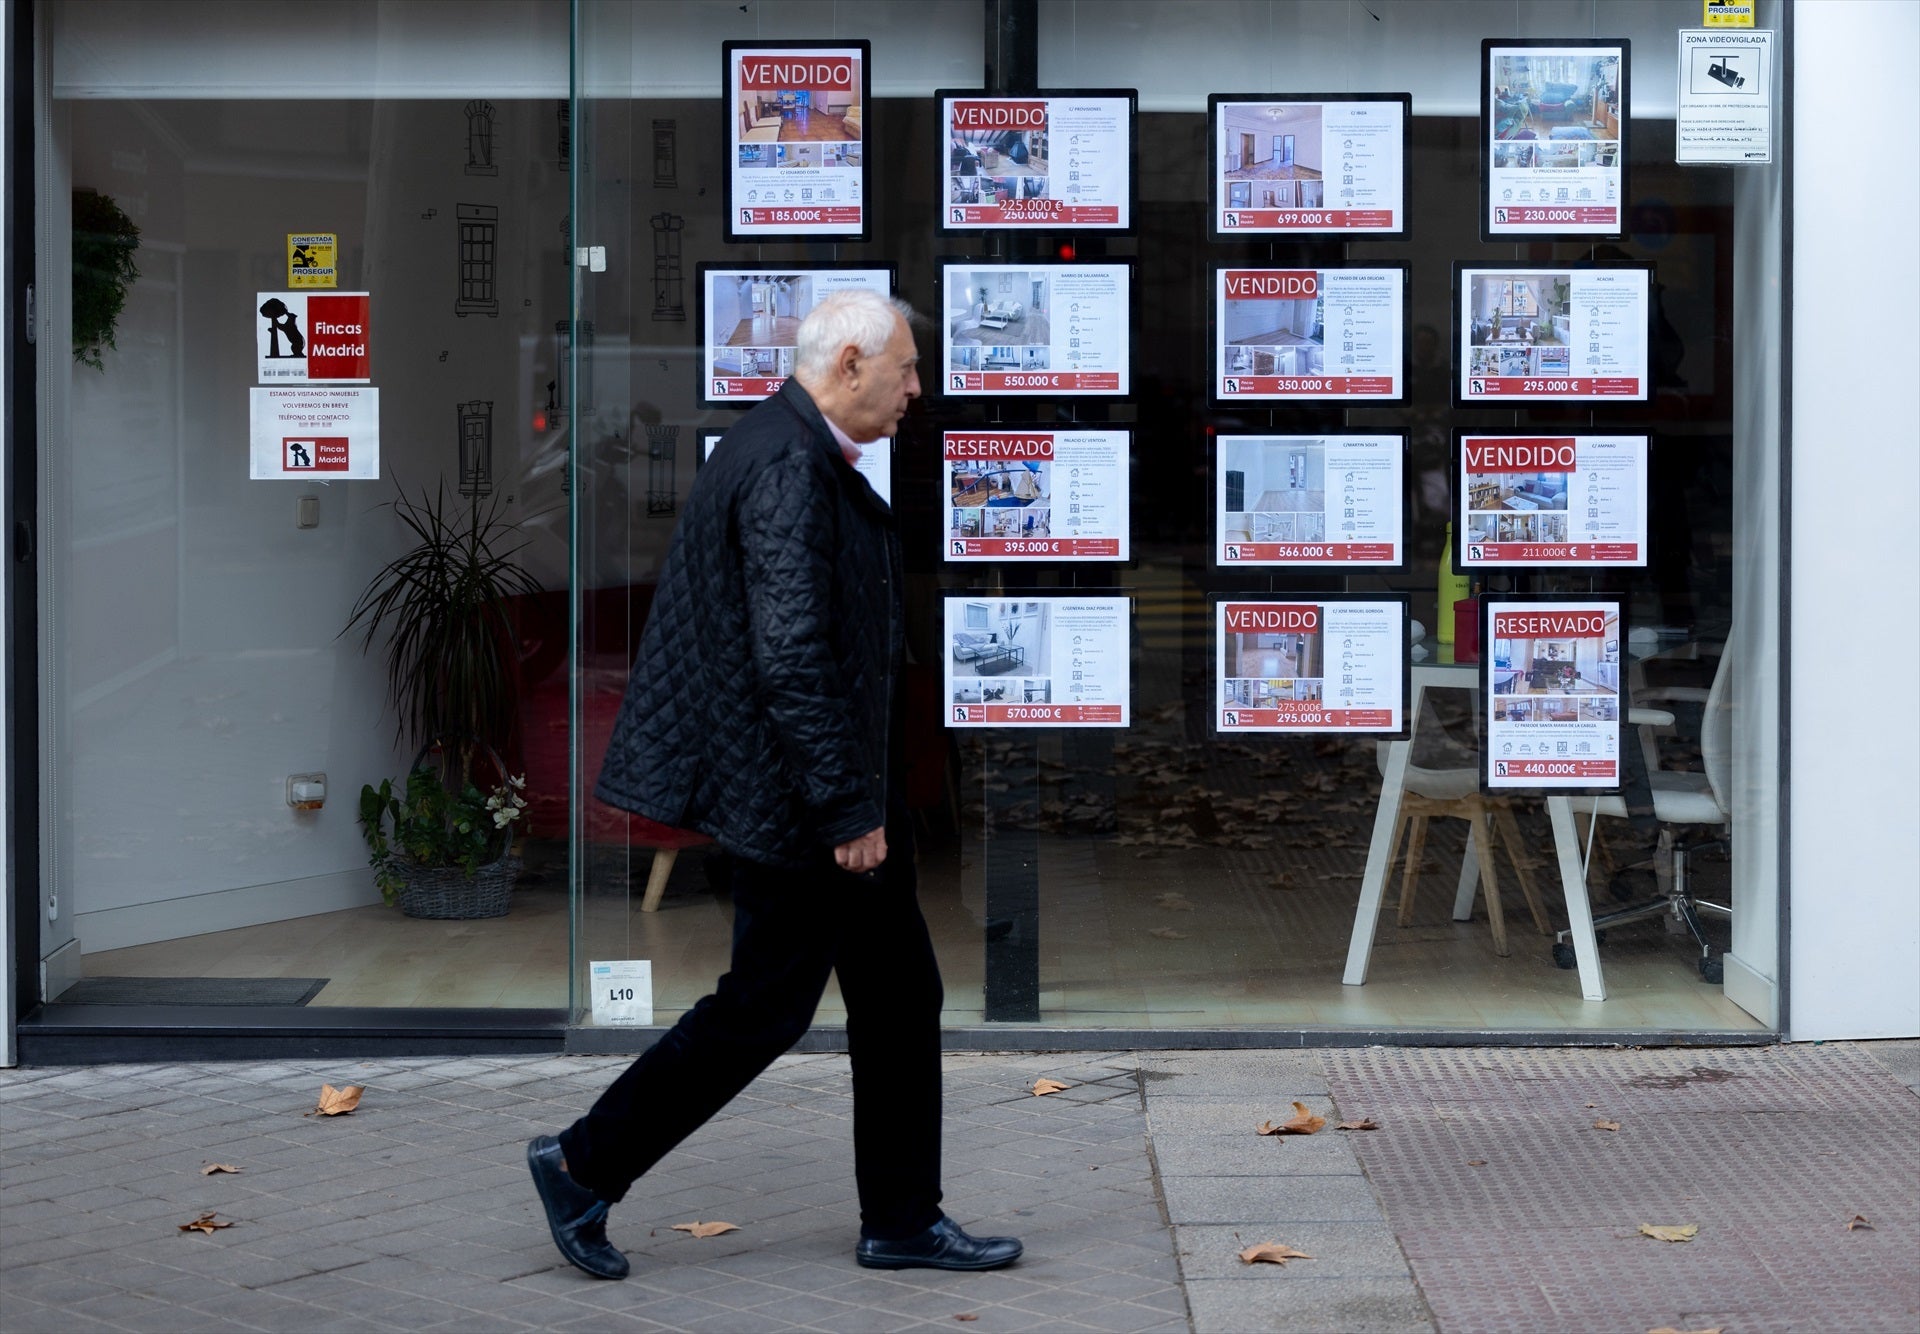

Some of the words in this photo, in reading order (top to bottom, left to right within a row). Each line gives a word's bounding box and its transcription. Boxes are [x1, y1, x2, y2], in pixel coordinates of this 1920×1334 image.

[742, 64, 851, 84] VENDIDO
[954, 108, 1045, 125] VENDIDO
[999, 199, 1051, 212] 225.000
[1055, 200, 1064, 212] €
[770, 210, 821, 221] 185.000€
[1051, 211, 1058, 220] €
[1278, 213, 1322, 224] 699.000
[1325, 213, 1333, 224] €
[1524, 210, 1576, 221] 230.000€
[1226, 277, 1316, 294] VENDIDO
[315, 322, 362, 335] Fincas
[312, 343, 365, 357] Madrid
[1004, 376, 1048, 386] 550.000
[1051, 376, 1059, 386] €
[1278, 380, 1322, 390] 350.000
[1325, 380, 1332, 390] €
[1524, 381, 1568, 391] 295.000
[1571, 381, 1578, 391] €
[946, 440, 1053, 456] RESERVADO
[318, 456, 347, 464] Madrid
[1466, 446, 1575, 466] VENDIDO
[1005, 542, 1049, 552] 395.000
[1052, 542, 1059, 552] €
[1279, 547, 1323, 557] 566.000
[1326, 547, 1333, 557] €
[1523, 548, 1566, 557] 211.000€
[1570, 547, 1577, 557] €
[1227, 611, 1317, 628] VENDIDO
[1496, 617, 1604, 634] RESERVADO
[1007, 708, 1051, 718] 570.000
[1054, 708, 1061, 718] €
[1278, 703, 1321, 712] 275.000€
[1278, 713, 1321, 723] 295.000
[1324, 713, 1332, 722] €
[1524, 764, 1576, 774] 440.000€
[610, 988, 633, 1000] L10
